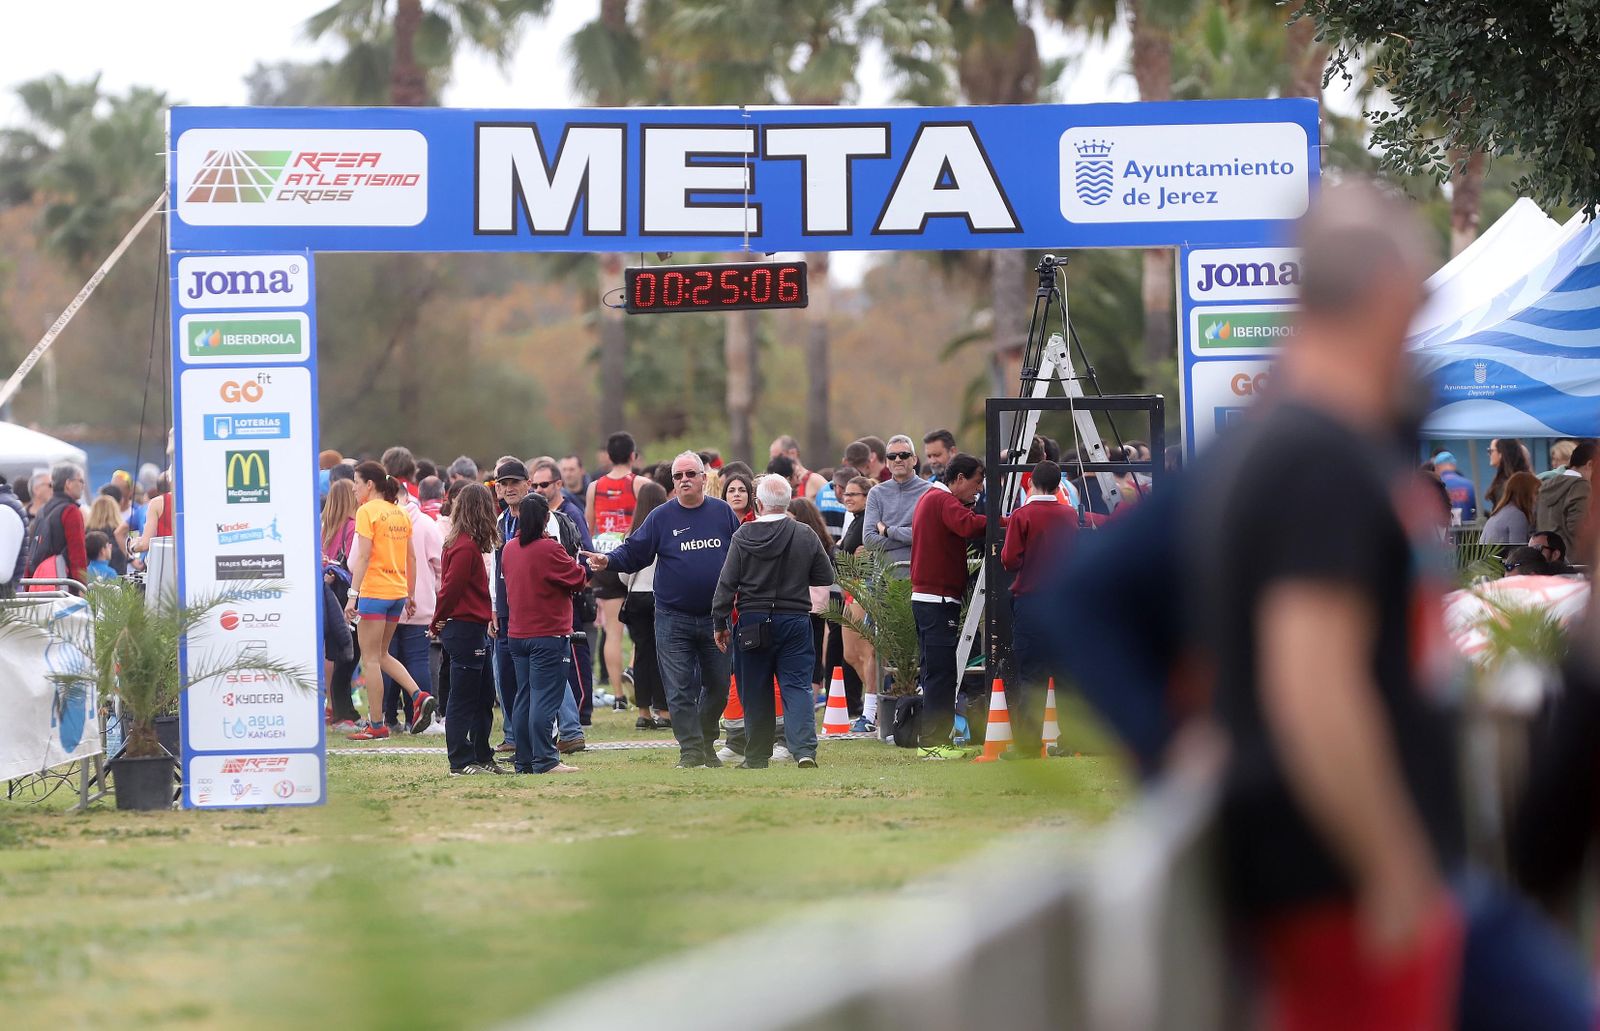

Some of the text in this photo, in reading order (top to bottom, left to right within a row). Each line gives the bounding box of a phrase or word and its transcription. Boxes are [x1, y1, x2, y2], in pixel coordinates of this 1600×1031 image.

[292, 152, 382, 171] RFEA
[1123, 158, 1294, 183] Ayuntamiento
[284, 173, 420, 187] ATLETISMO
[473, 120, 1025, 237] META
[276, 189, 354, 204] CROSS
[1123, 187, 1218, 210] de Jerez
[635, 267, 799, 307] 00:25:06
[222, 333, 296, 346] IBERDROLA
[256, 373, 272, 385] fit
[219, 380, 264, 404] GO
[234, 416, 280, 427] LOTERÍAS
[681, 538, 721, 552] MÉDICO
[242, 613, 281, 622] DJO
[248, 714, 285, 731] agua
[247, 729, 286, 739] KANGEN
[246, 757, 289, 768] RFEA
